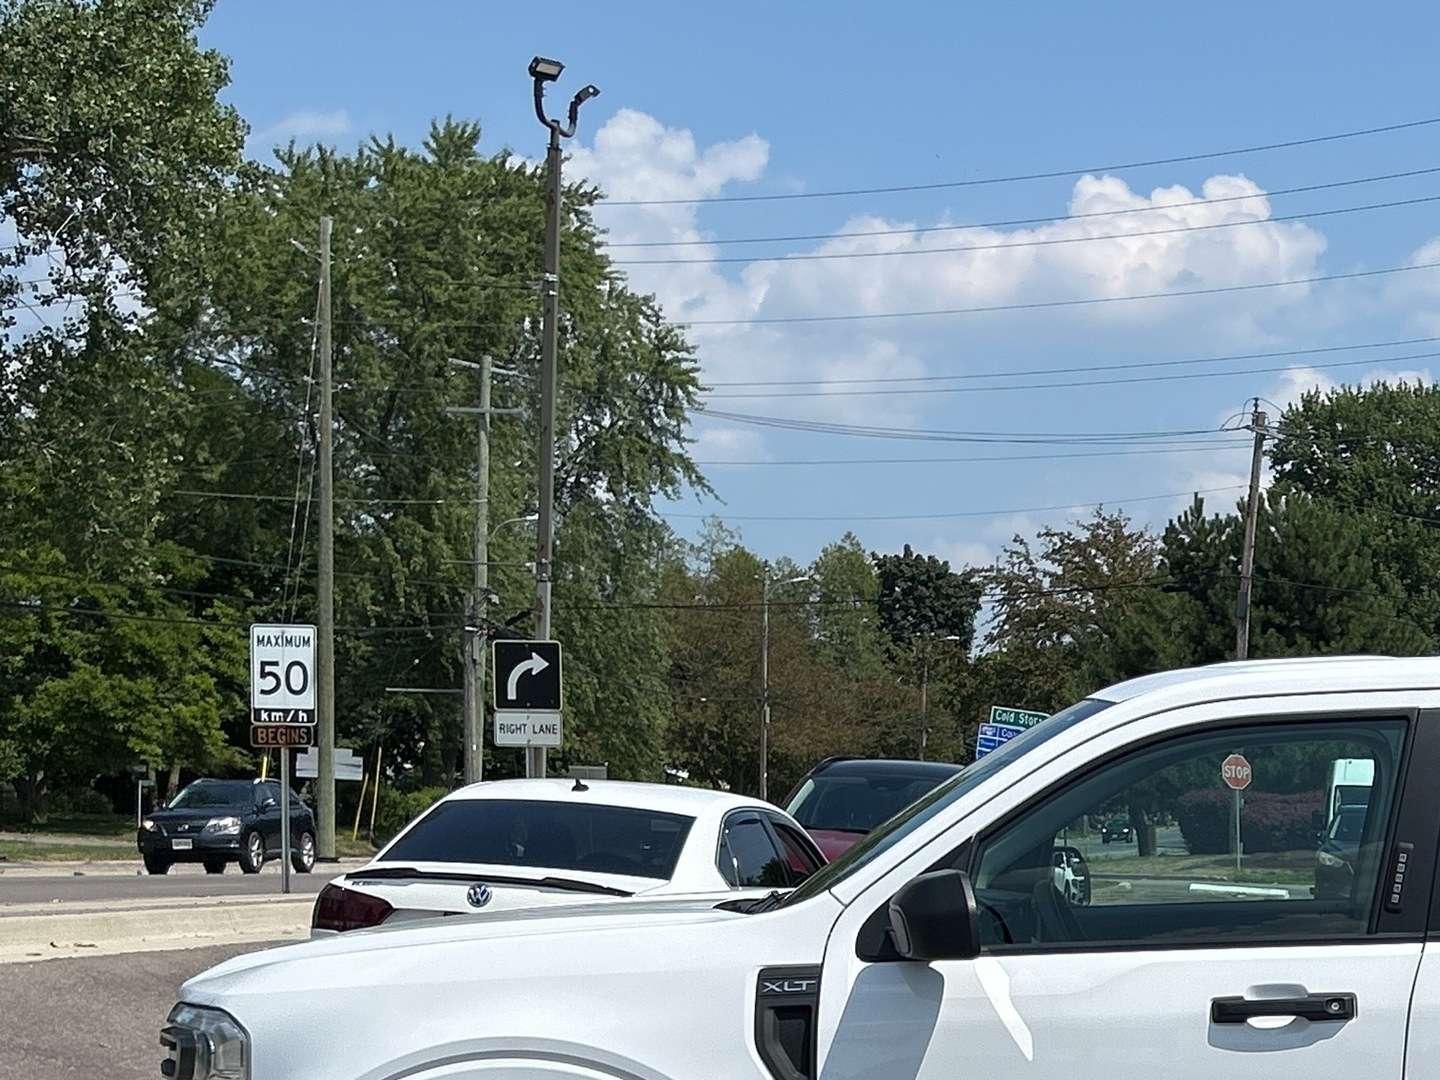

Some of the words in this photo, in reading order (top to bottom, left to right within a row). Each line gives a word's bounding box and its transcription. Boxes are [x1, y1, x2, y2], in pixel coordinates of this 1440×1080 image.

[256, 635, 311, 648] MAXIMUM
[260, 660, 309, 695] 50
[261, 709, 308, 722] km/h
[995, 709, 1015, 723] Cold
[499, 723, 528, 735] RIGHT
[533, 723, 558, 735] LANE
[257, 728, 308, 744] BEGINS
[1224, 765, 1250, 779] STOP
[762, 980, 817, 992] XLT
